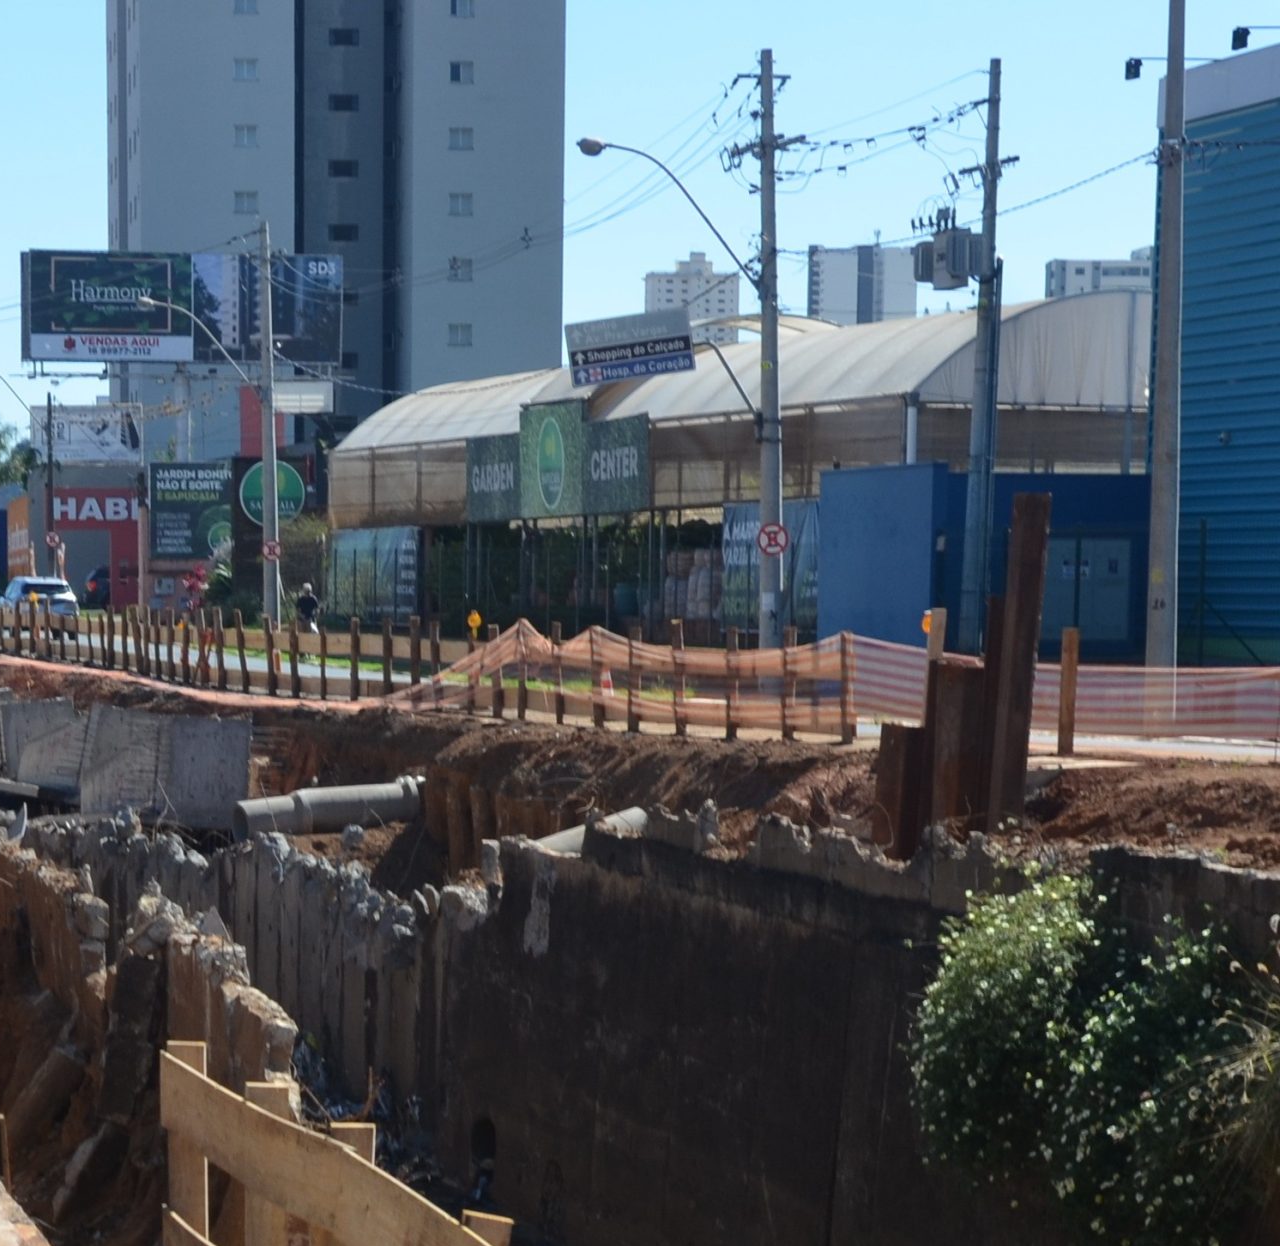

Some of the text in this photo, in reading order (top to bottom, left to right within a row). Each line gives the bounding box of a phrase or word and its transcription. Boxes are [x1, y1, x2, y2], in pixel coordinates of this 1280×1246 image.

[70, 279, 152, 302] Harmony
[80, 336, 160, 348] VENDAS AQUI
[587, 347, 632, 363] Shopping
[647, 339, 685, 353] Calçado
[602, 366, 632, 378] Hosp.
[649, 357, 691, 372] Coração
[472, 447, 639, 493] GARDEN CENTER
[156, 479, 179, 490] NÃO
[250, 500, 296, 511] SAAIA
